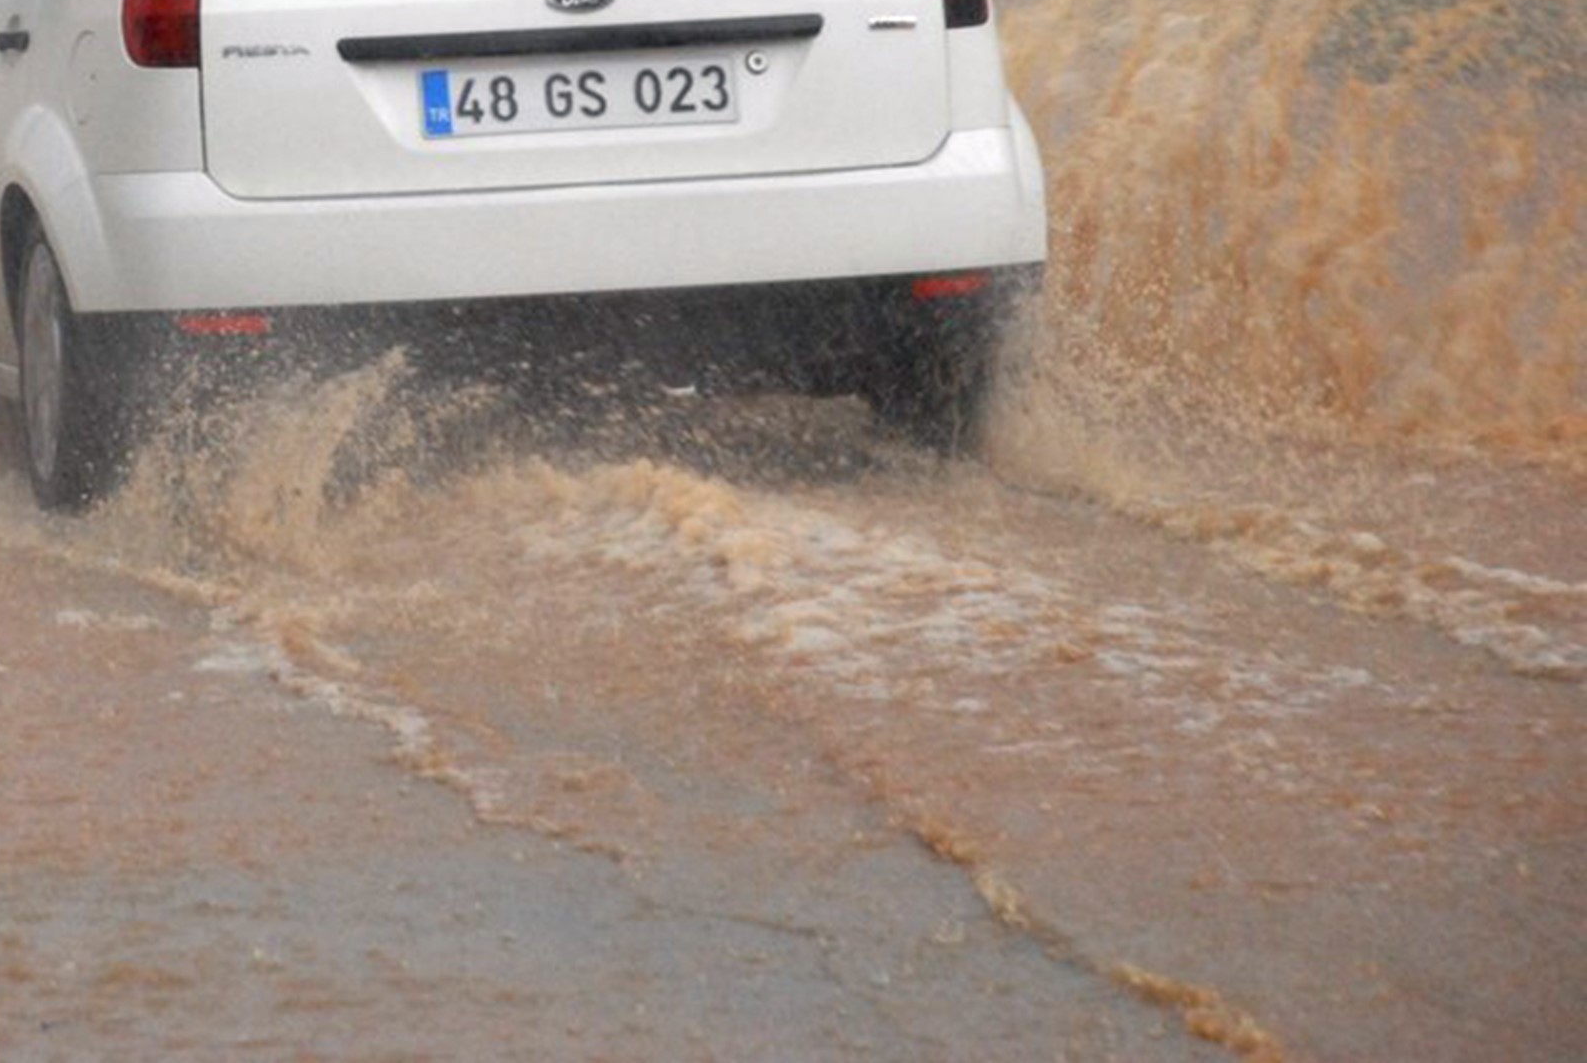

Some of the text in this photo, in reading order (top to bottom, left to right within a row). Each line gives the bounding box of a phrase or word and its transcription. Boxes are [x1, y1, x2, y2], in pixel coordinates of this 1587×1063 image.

[456, 65, 730, 123] 48 GS 023
[429, 106, 450, 124] TR
